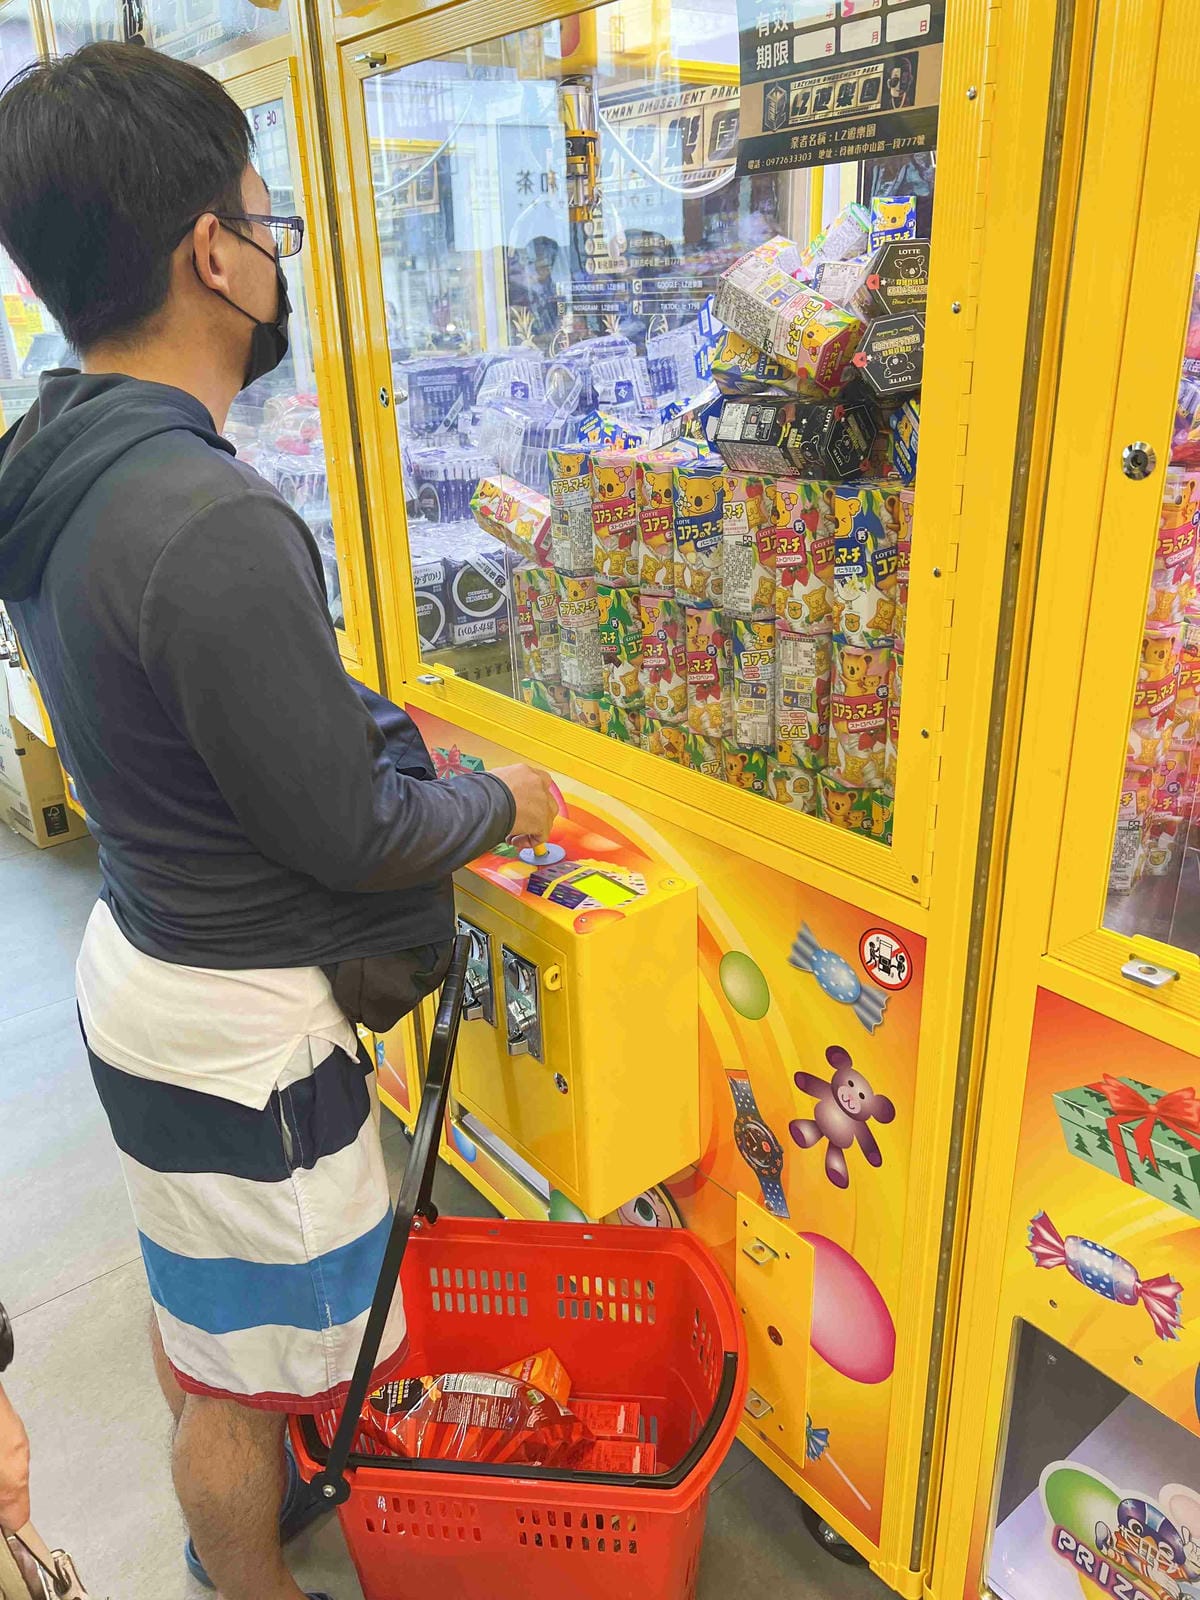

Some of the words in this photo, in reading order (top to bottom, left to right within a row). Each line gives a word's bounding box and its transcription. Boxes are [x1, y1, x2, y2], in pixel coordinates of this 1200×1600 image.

[755, 7, 789, 38] 有效
[825, 43, 833, 54] 年
[872, 31, 879, 44] 月
[920, 20, 928, 32] 日
[756, 40, 789, 71] 期限
[889, 375, 912, 384] LOTTE
[594, 503, 637, 524] コアラのマーチ
[874, 549, 897, 559] LOTTE
[559, 599, 598, 616] コアラのマーチ
[833, 701, 885, 721] コアラのマーチ
[849, 719, 885, 730] ストロベリー
